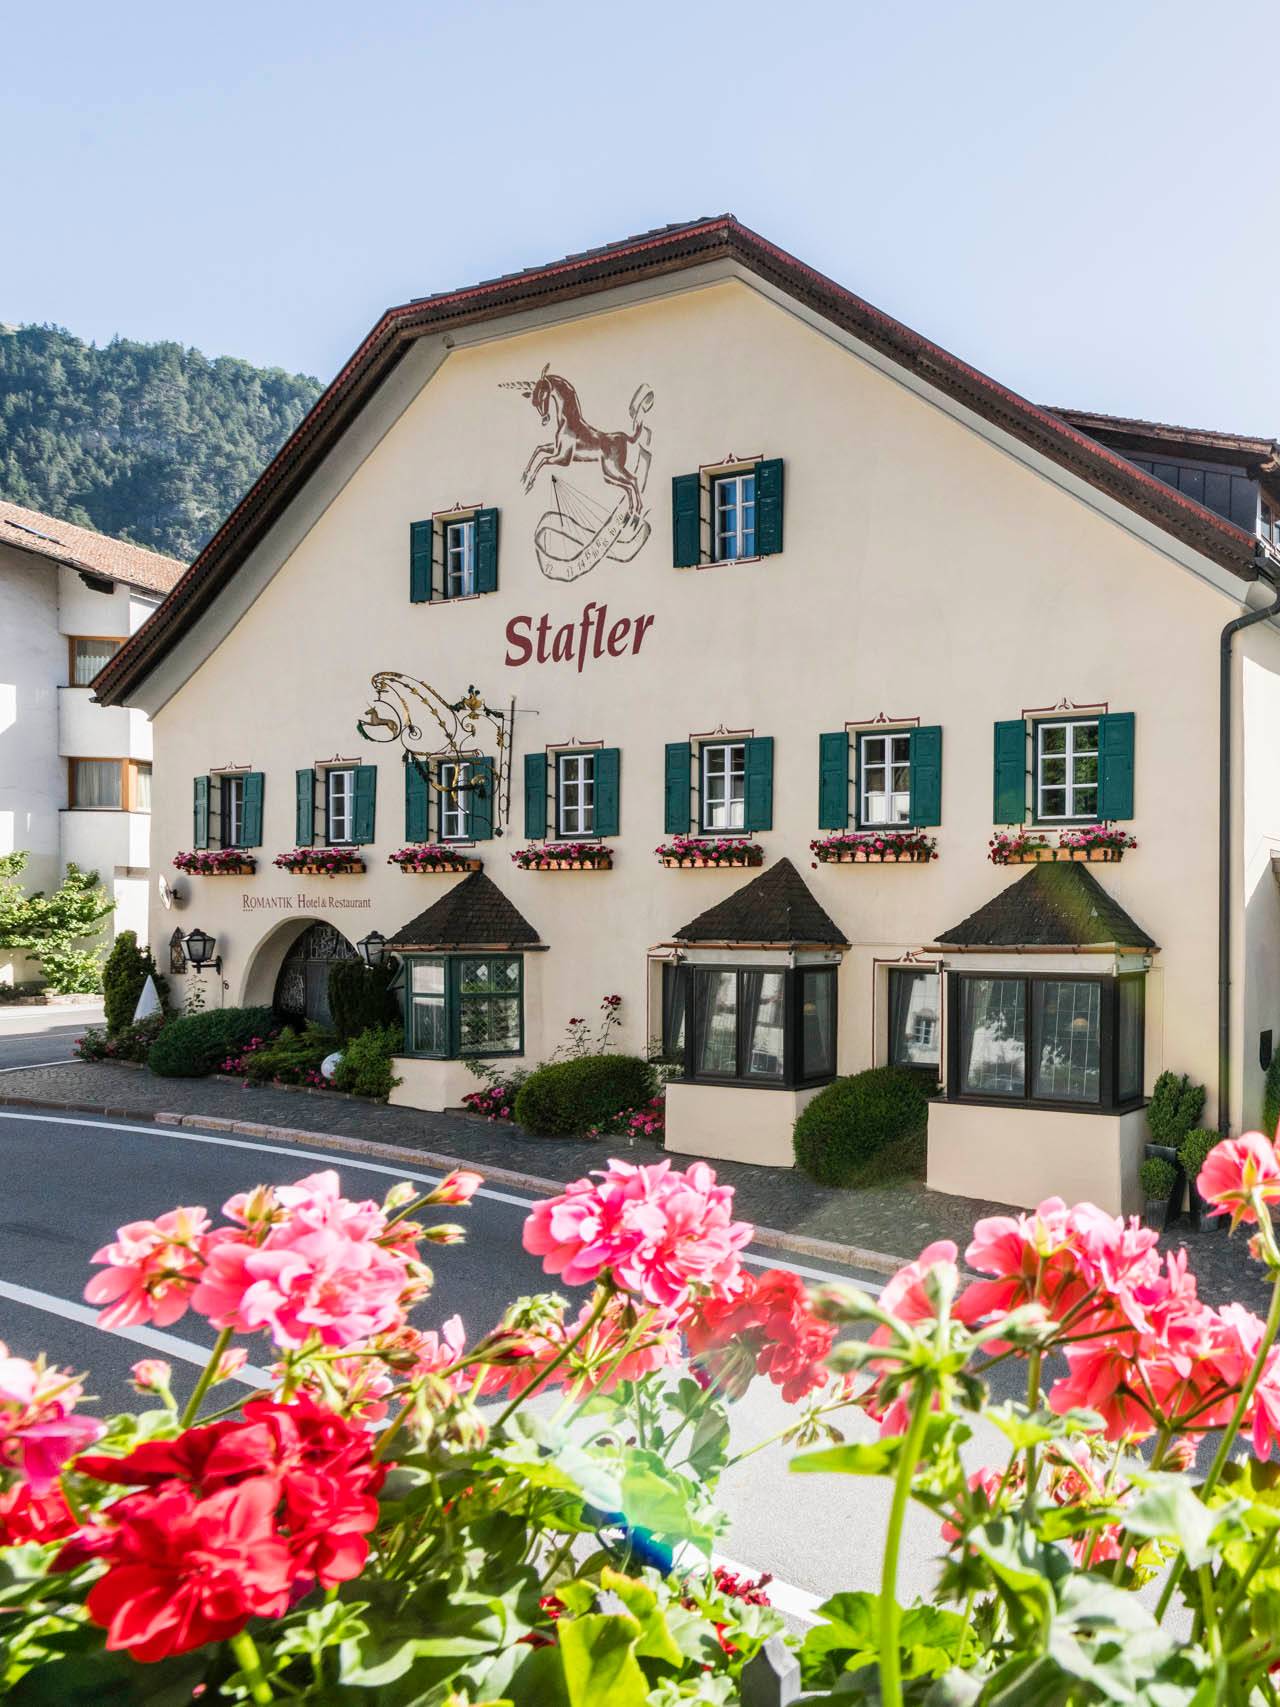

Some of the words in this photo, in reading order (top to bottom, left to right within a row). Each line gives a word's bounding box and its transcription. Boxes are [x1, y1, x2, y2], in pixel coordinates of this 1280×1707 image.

[504, 601, 655, 673] Stafler
[242, 894, 293, 909] ROMANTIK
[297, 894, 321, 909] Hotel
[321, 900, 327, 908] &
[328, 896, 371, 909] Restaurant
